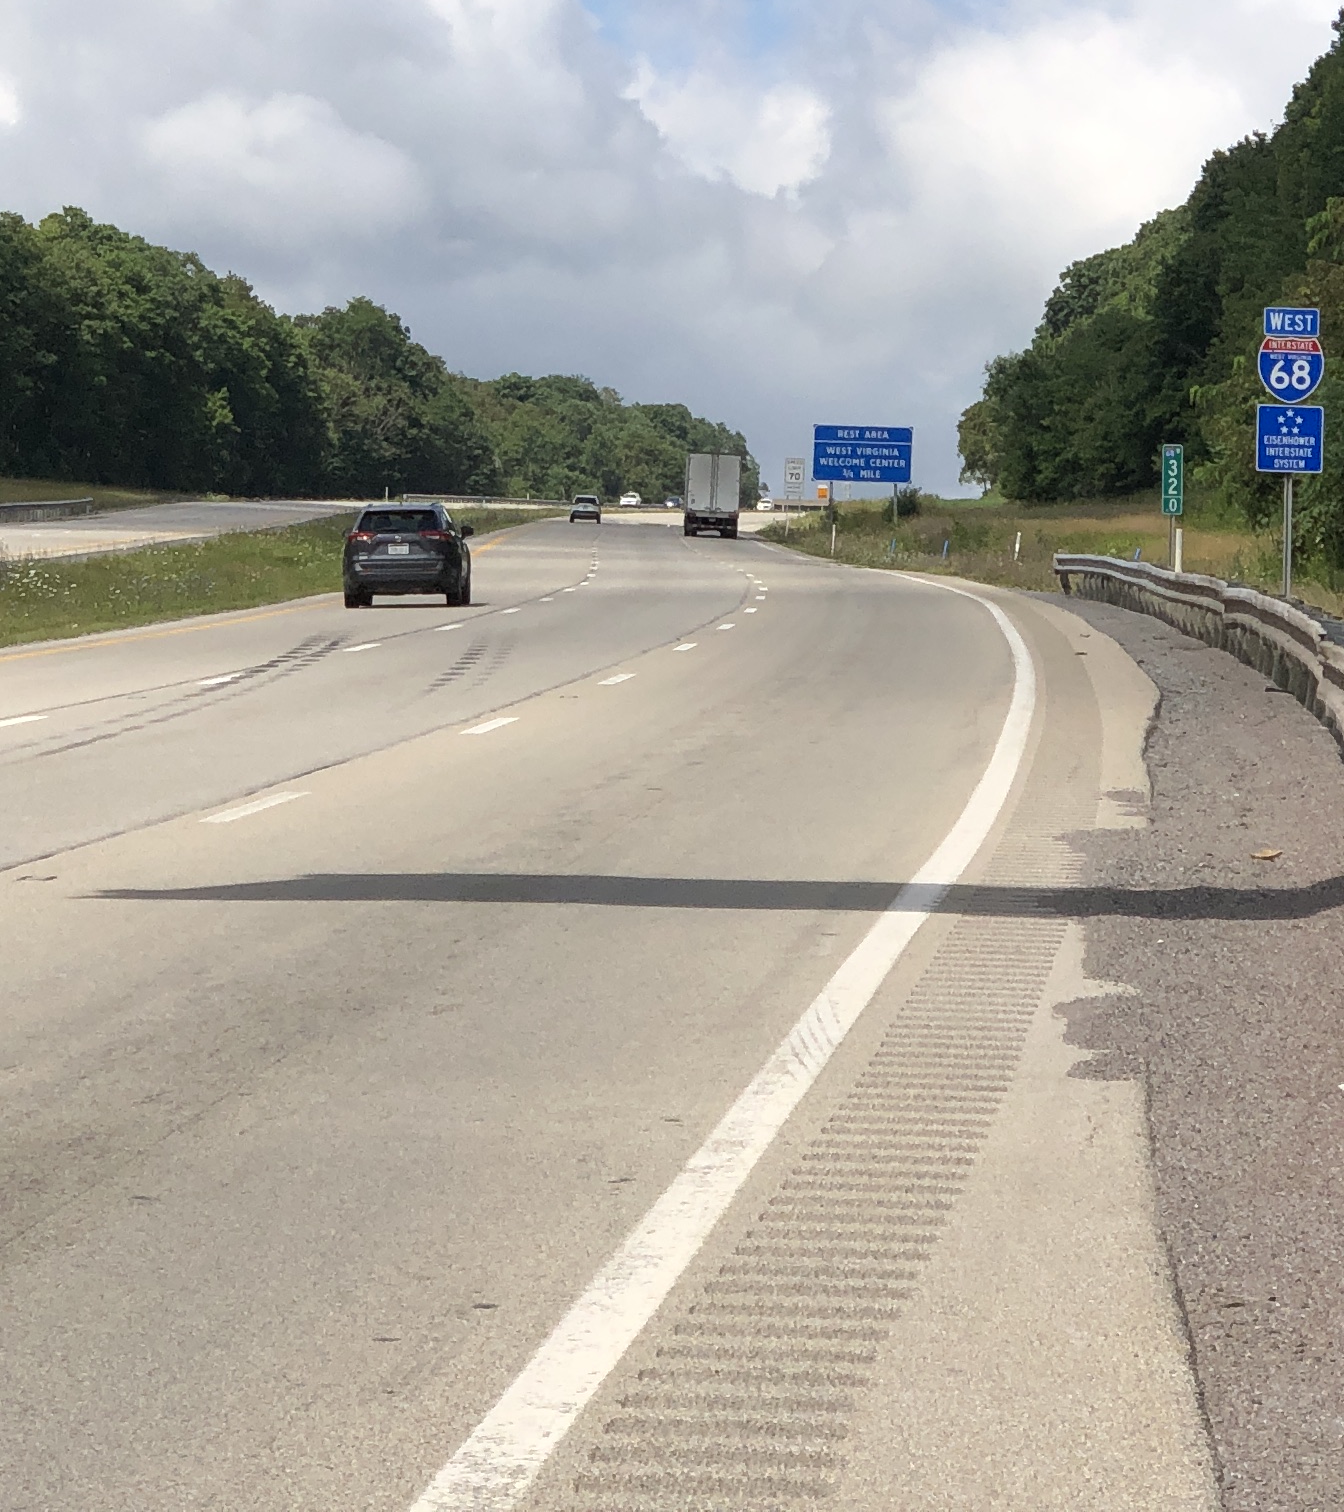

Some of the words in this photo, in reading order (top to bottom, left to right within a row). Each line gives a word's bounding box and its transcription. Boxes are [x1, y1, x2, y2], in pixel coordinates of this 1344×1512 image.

[1269, 312, 1314, 332] WEST
[1268, 340, 1314, 351] INTERSTATE
[1270, 359, 1311, 390] 68
[837, 429, 860, 438] REST
[864, 430, 890, 439] AREA
[1263, 435, 1316, 446] EISENHOWER
[825, 446, 852, 455] WEST
[856, 447, 900, 457] VIRGINIA
[1265, 447, 1313, 458] INTERSTATE
[819, 457, 865, 467] WELCOME
[869, 458, 906, 468] CENTER
[1273, 458, 1306, 469] SYSTEM
[788, 472, 801, 481] 70
[859, 469, 881, 479] MILE
